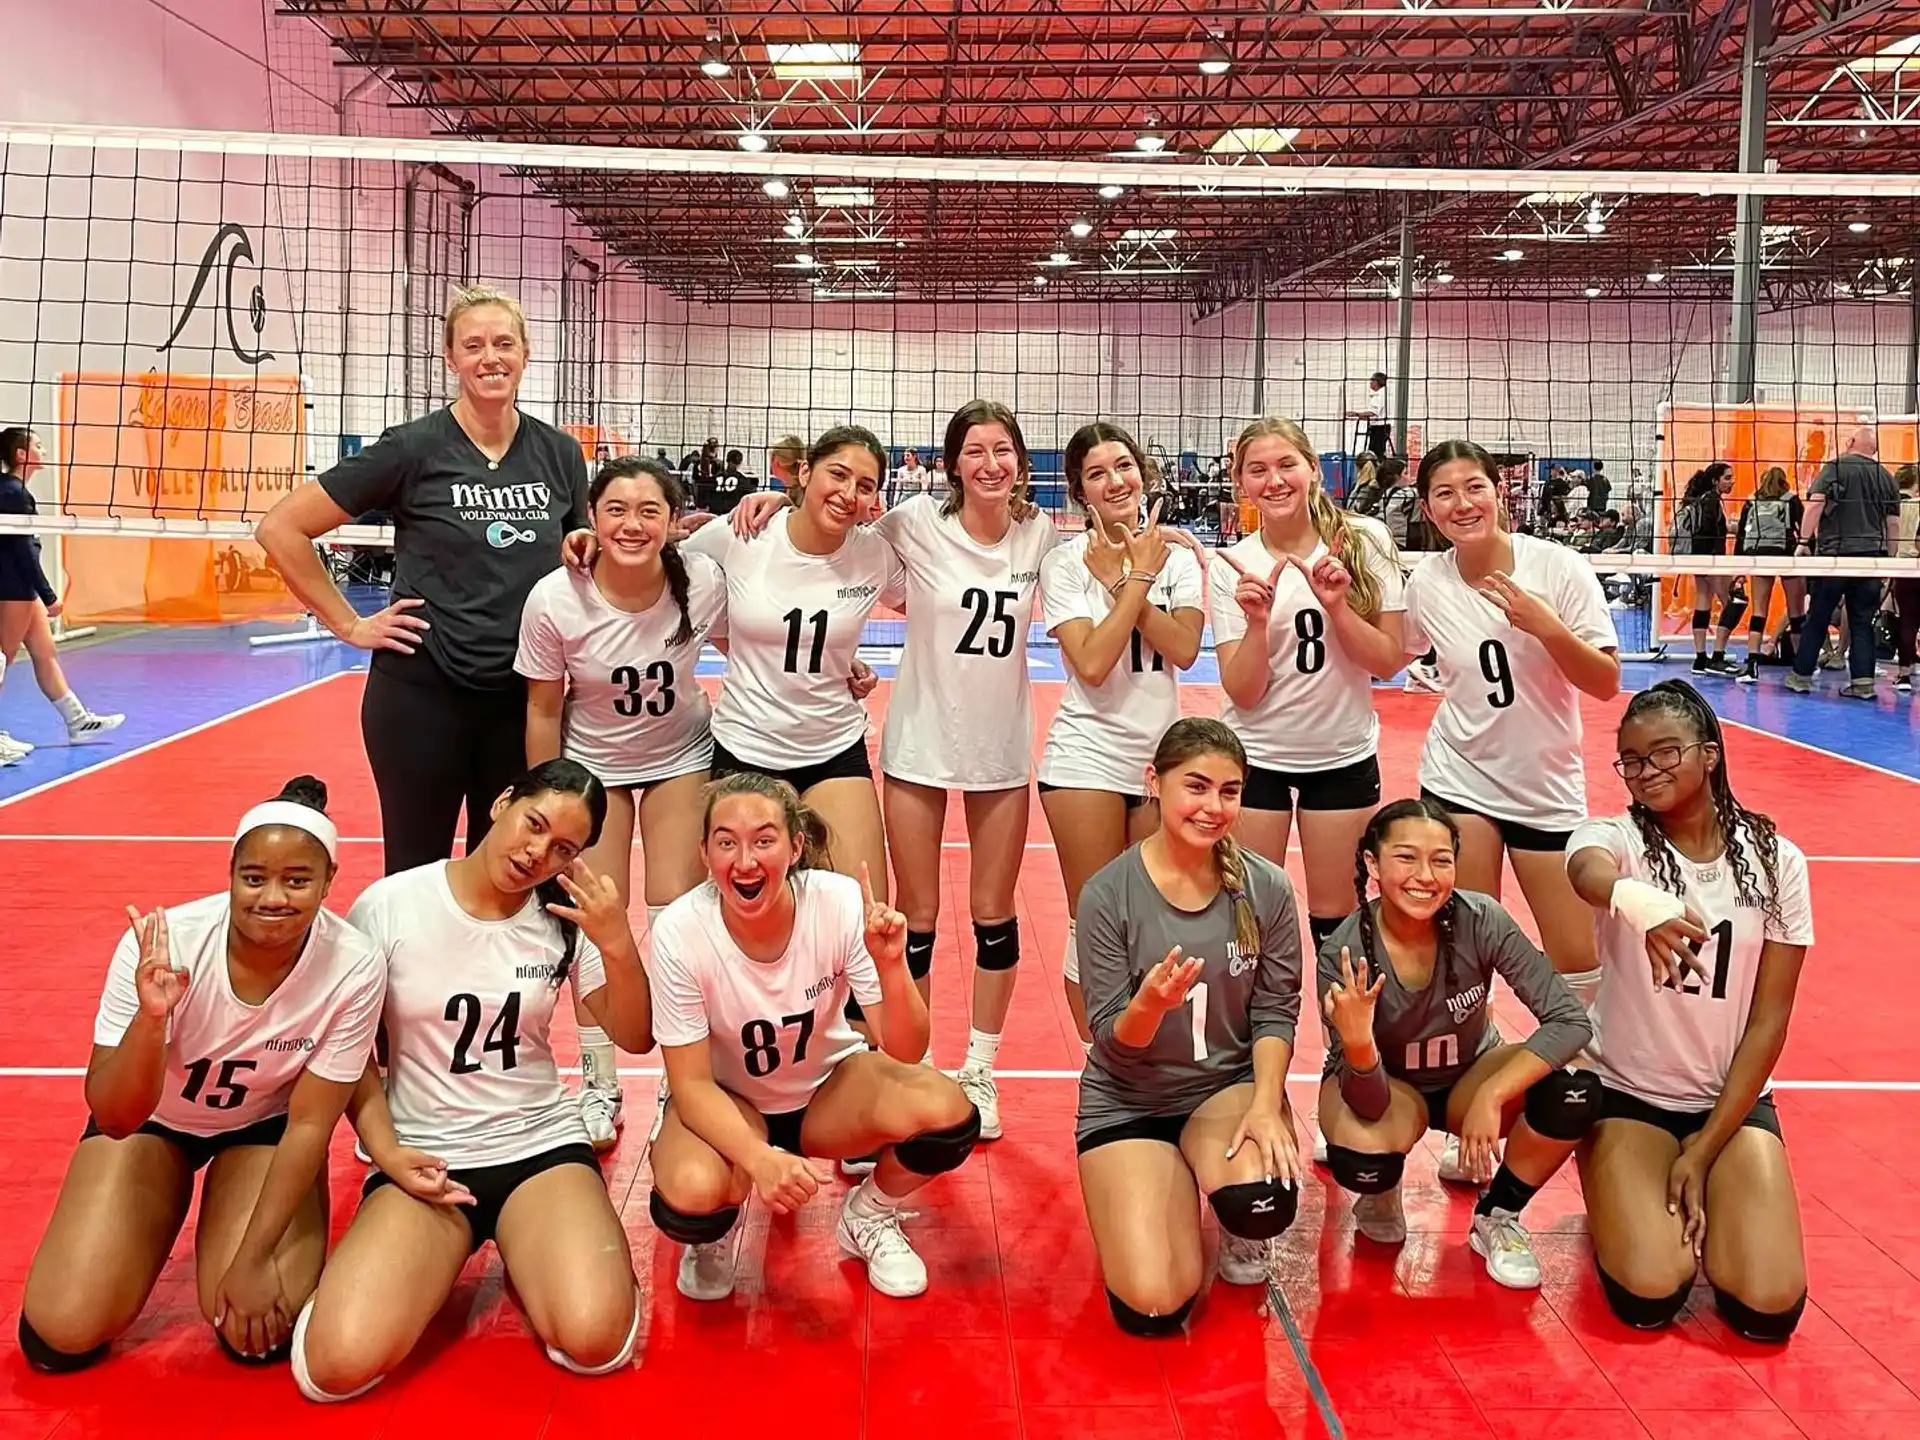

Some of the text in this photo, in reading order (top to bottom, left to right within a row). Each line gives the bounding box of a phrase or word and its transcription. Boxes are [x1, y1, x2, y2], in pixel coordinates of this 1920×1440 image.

[460, 510, 550, 520] VOLLEYBALL CLUB
[715, 475, 739, 492] 10
[783, 607, 828, 673] 11
[954, 588, 1019, 658] 25
[1294, 608, 1325, 674] 8
[611, 660, 675, 717] 33
[1479, 639, 1515, 708] 9
[444, 991, 521, 1074] 24
[741, 1009, 814, 1077] 87
[1186, 982, 1208, 1061] 1
[180, 1057, 257, 1110] 15
